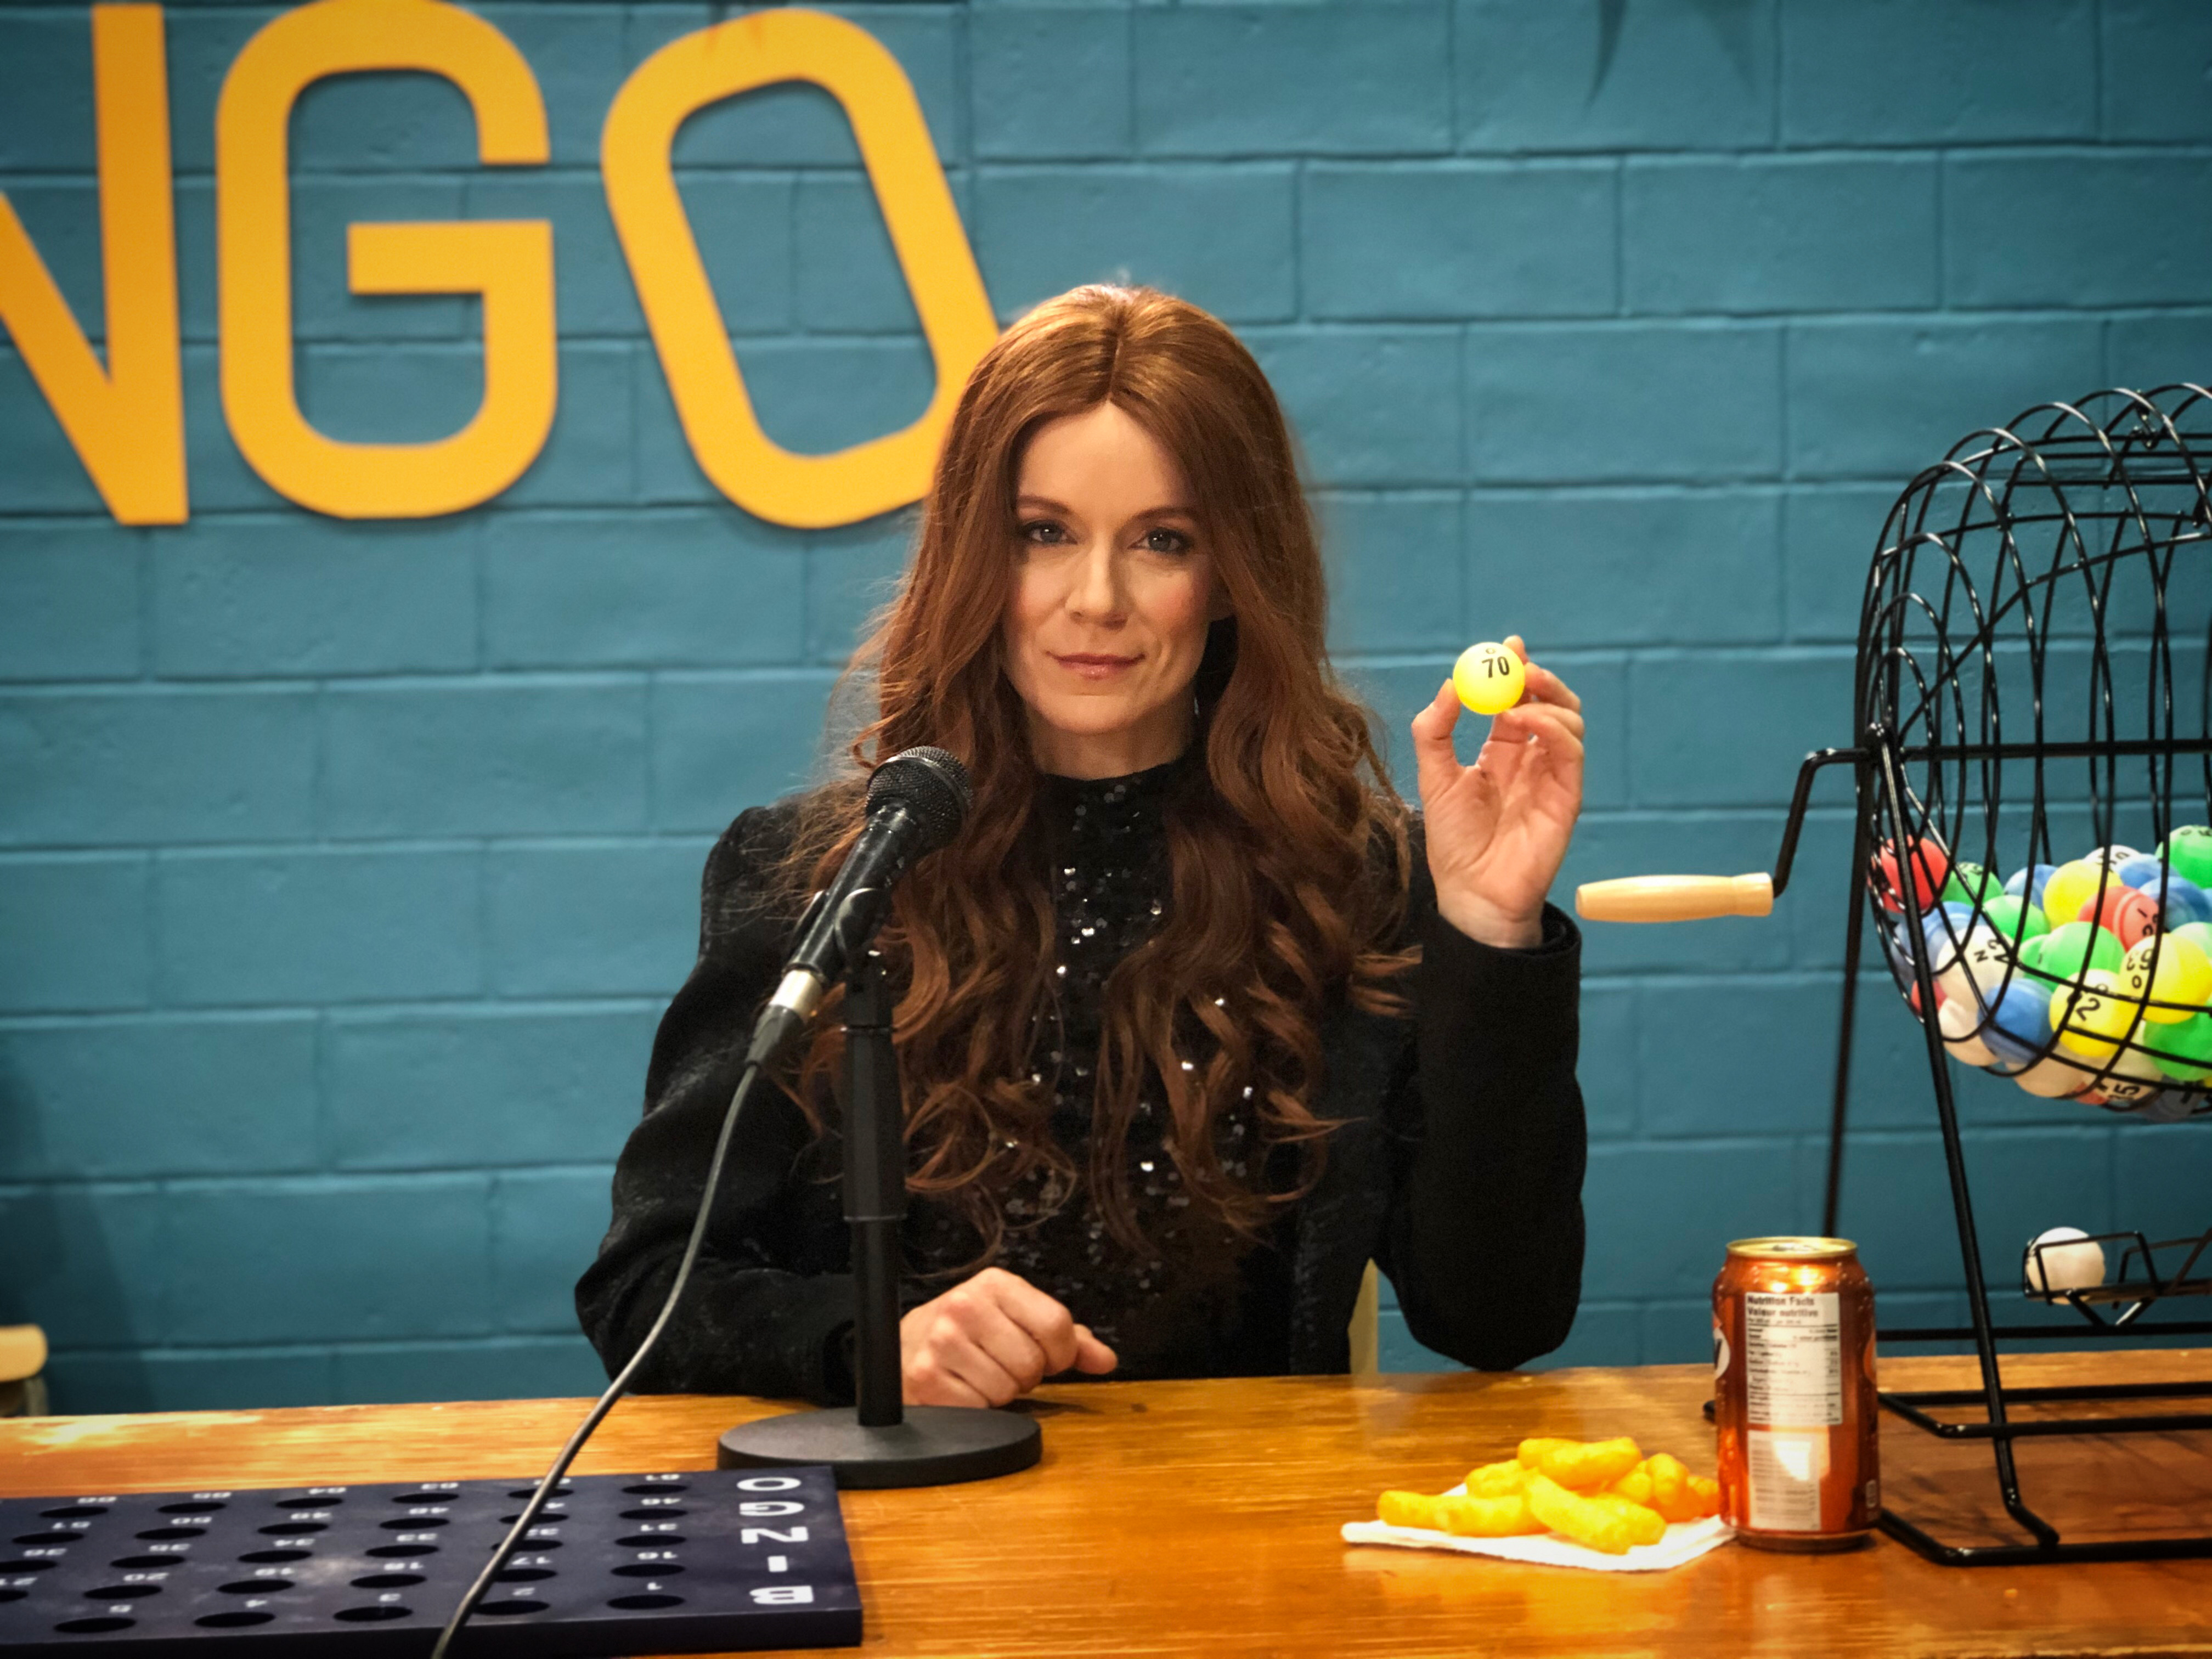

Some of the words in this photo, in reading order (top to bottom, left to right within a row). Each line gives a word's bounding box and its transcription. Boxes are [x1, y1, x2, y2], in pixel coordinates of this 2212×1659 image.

[0, 0, 1000, 528] NGO
[1481, 656, 1510, 678] 70
[1748, 1296, 1786, 1305] Nutrition
[1790, 1296, 1815, 1306] Facts
